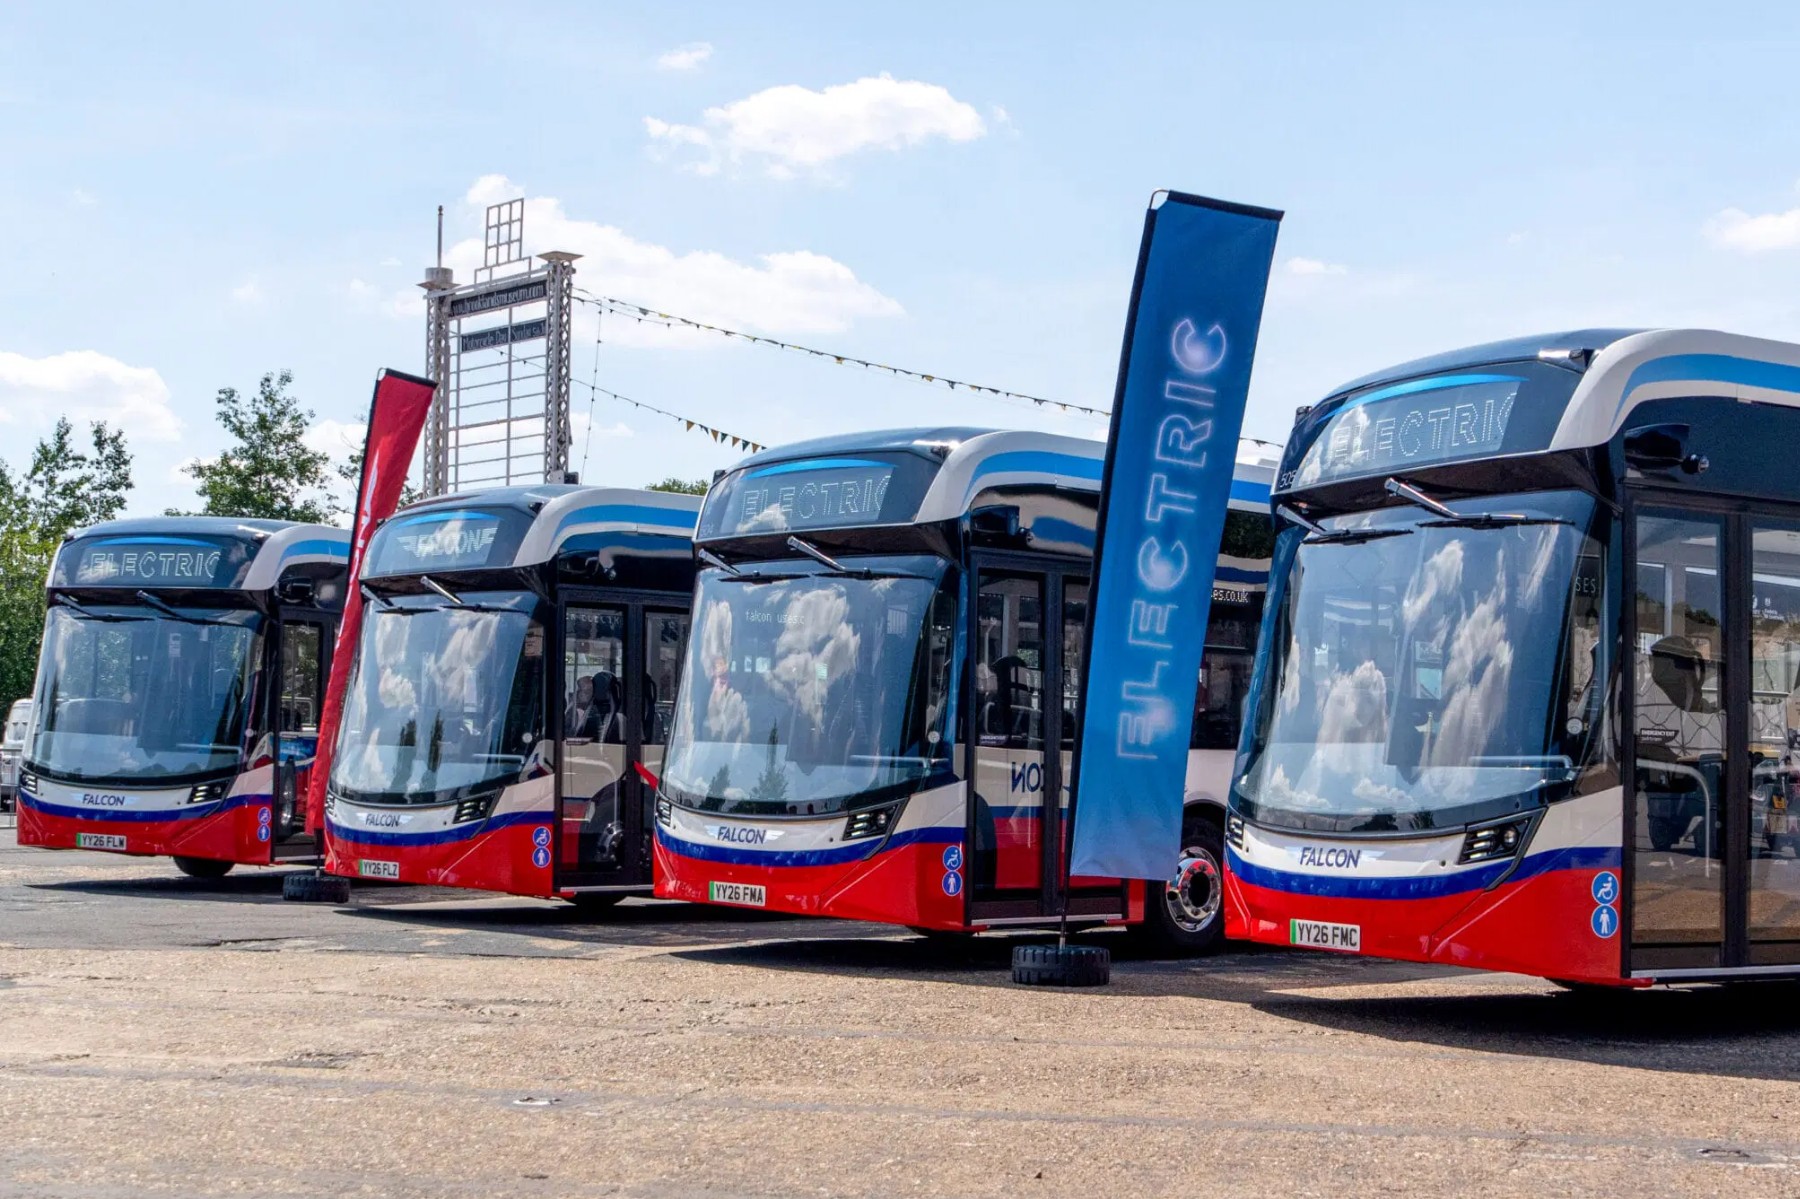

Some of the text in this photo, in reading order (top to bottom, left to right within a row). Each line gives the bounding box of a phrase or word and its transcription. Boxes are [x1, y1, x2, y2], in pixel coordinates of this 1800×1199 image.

[1116, 318, 1227, 760] ELECTRIC
[90, 551, 221, 578] ELECTRIC
[1211, 588, 1249, 603] es.co.uk
[82, 793, 125, 806] FALCON
[365, 813, 400, 827] FALCON
[82, 834, 104, 846] YY26
[717, 826, 766, 844] FALCON
[1299, 846, 1361, 868] FALCON
[363, 860, 398, 876] YY26 FLZ
[715, 883, 763, 903] YY26 FMA
[1297, 922, 1357, 947] YY26 FMC
